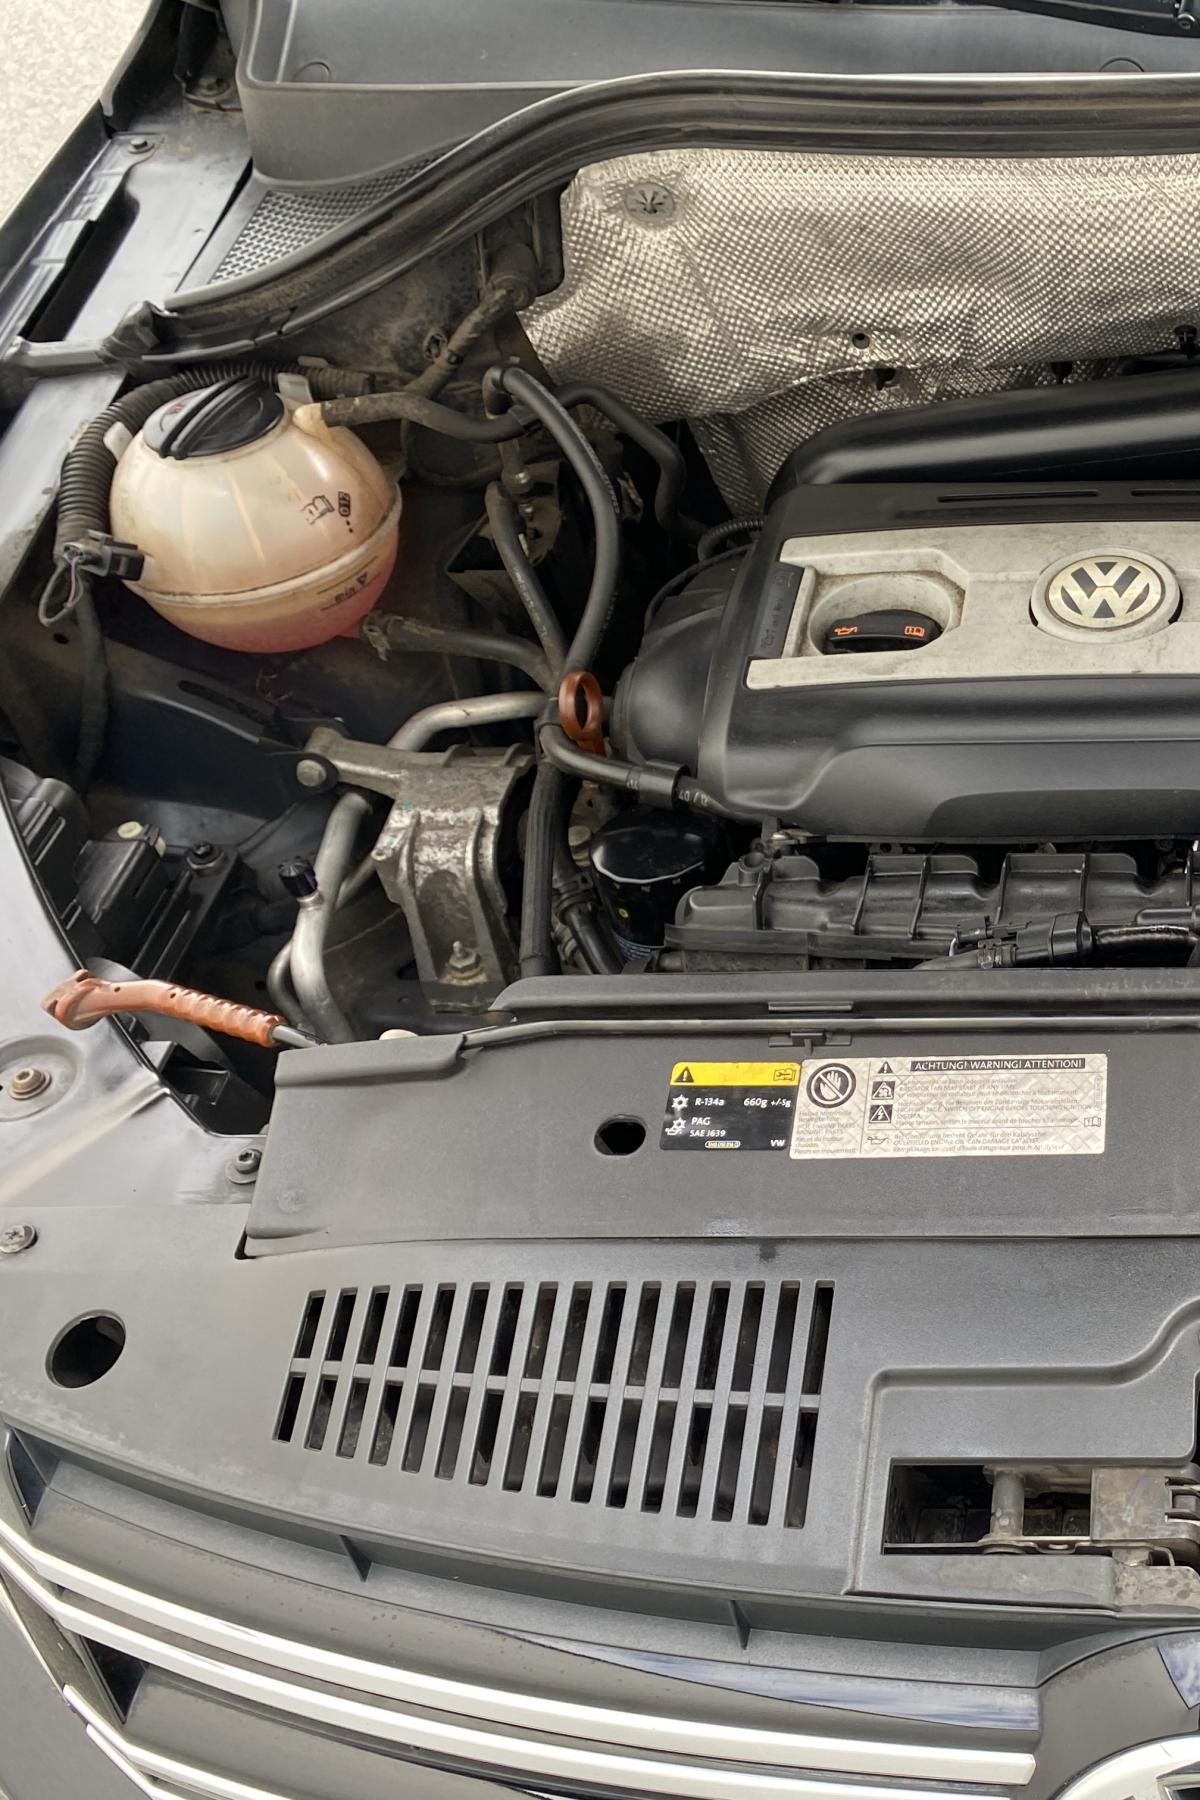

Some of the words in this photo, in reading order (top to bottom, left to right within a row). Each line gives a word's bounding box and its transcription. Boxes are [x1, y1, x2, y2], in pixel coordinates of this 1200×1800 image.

[914, 1061, 967, 1070] ACHTUNG!
[970, 1060, 1022, 1069] WARNING!
[1023, 1059, 1082, 1069] ATTENTION!
[694, 1097, 725, 1106] R-134a
[743, 1097, 768, 1108] 660g
[691, 1117, 711, 1126] PAG
[770, 1139, 786, 1147] VW
